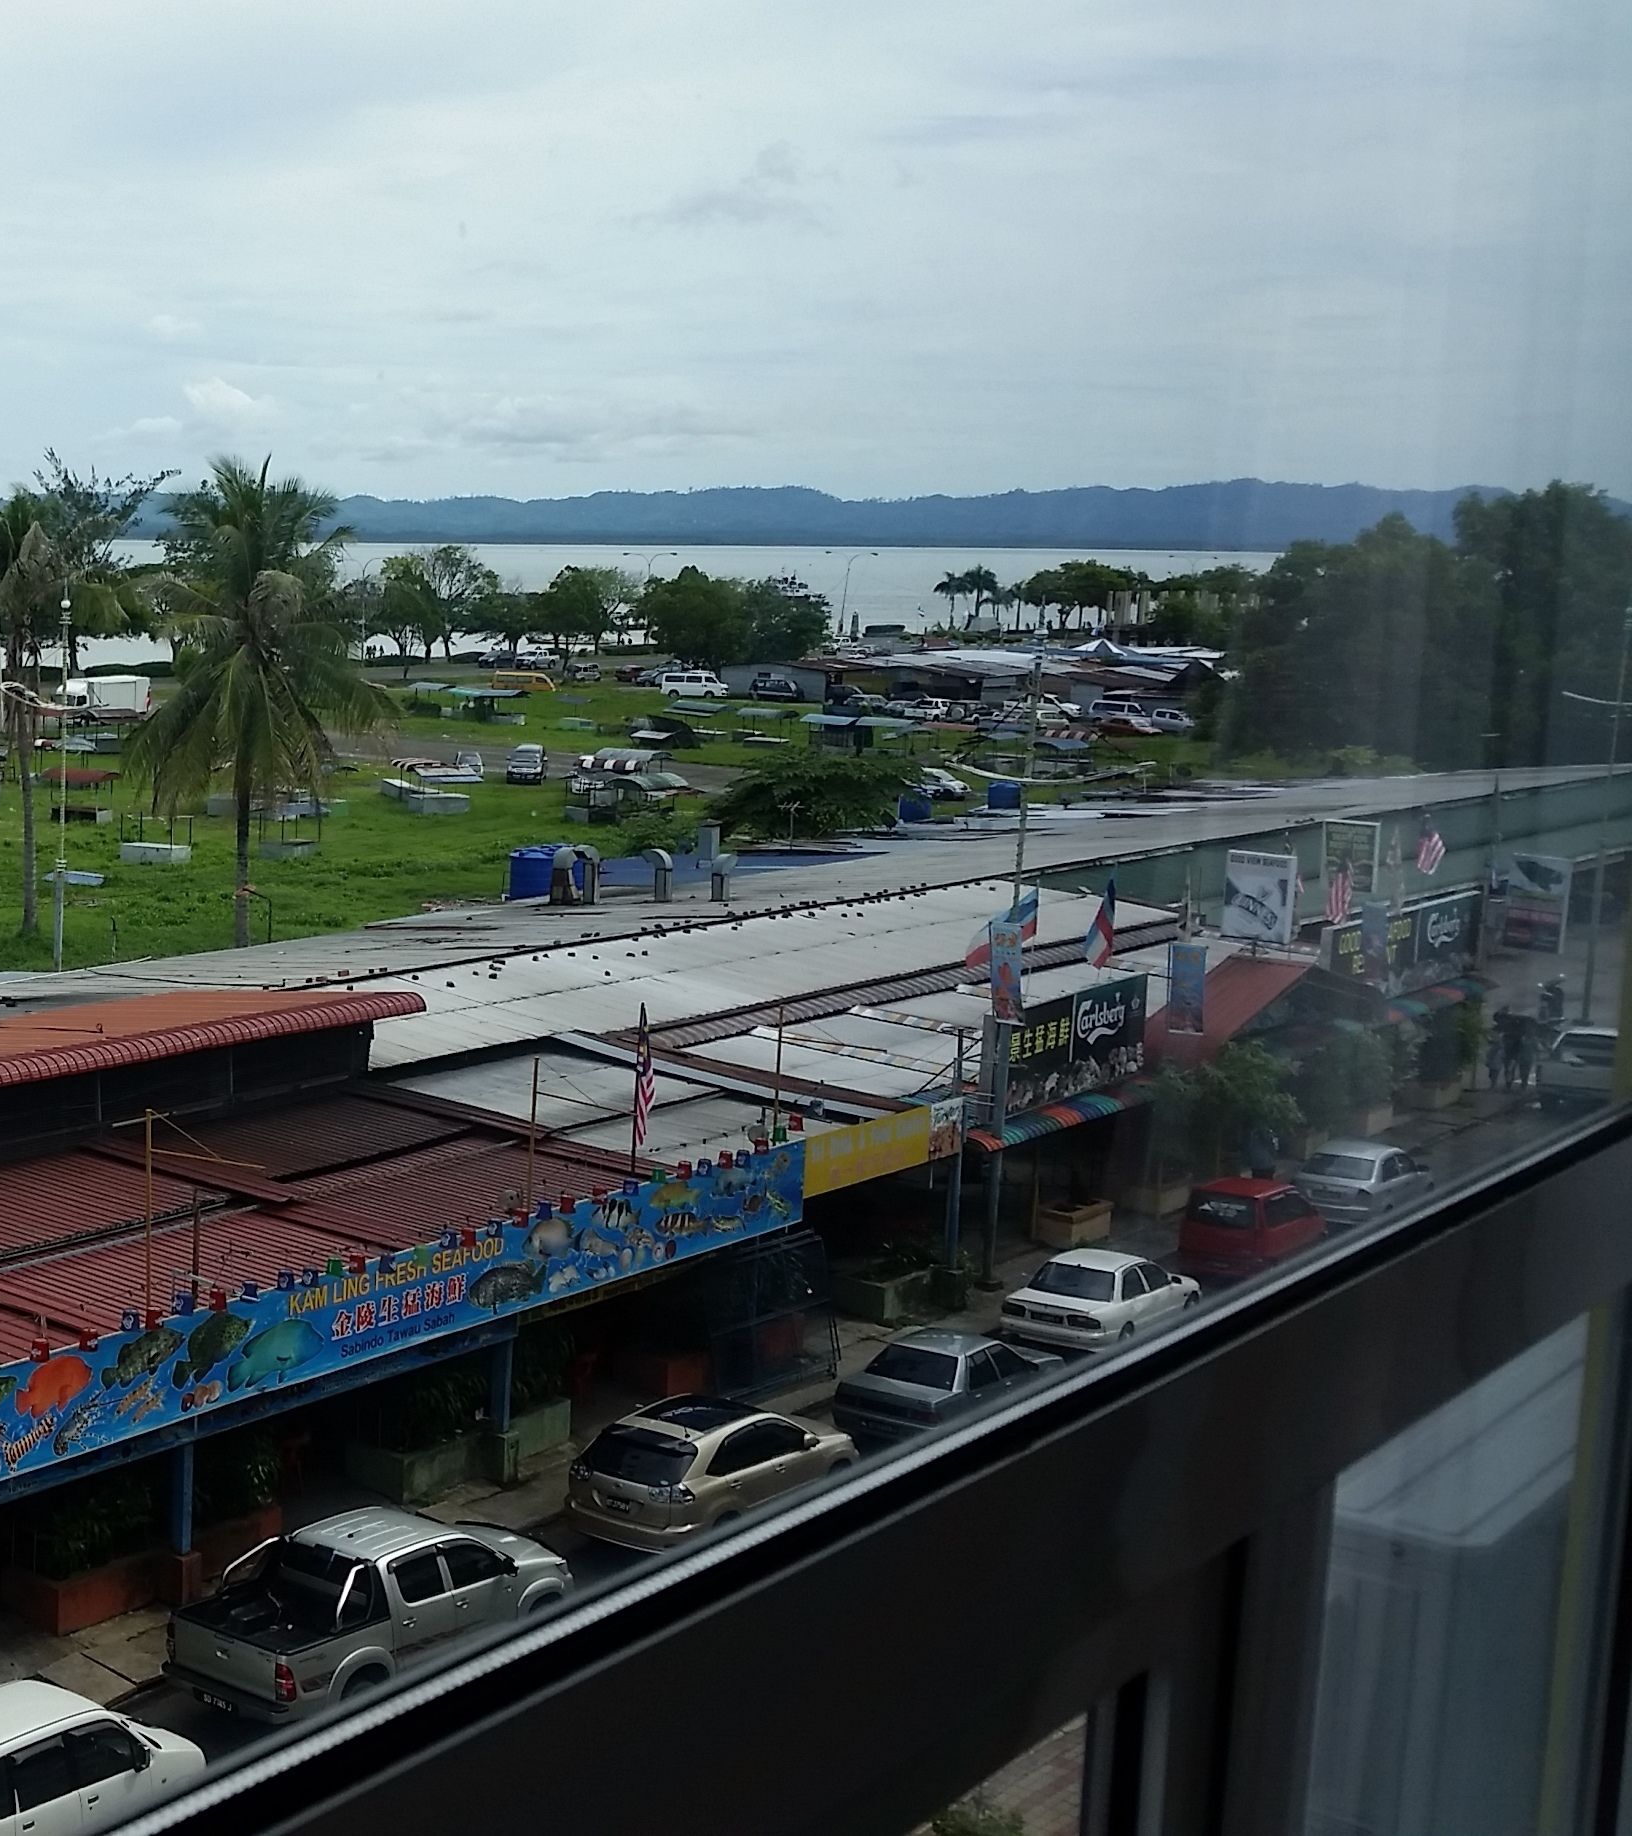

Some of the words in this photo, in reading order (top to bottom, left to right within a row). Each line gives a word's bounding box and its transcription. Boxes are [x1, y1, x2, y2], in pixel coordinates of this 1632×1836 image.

[1077, 999, 1127, 1040] Carlsberg
[288, 1285, 327, 1315] KAM
[333, 1273, 370, 1304] LING
[375, 1258, 427, 1291] FRESH
[432, 1238, 504, 1273] SEAFOOD
[340, 1334, 384, 1358] Sabindo
[387, 1323, 420, 1346] Tawau
[423, 1312, 456, 1332] Sabah
